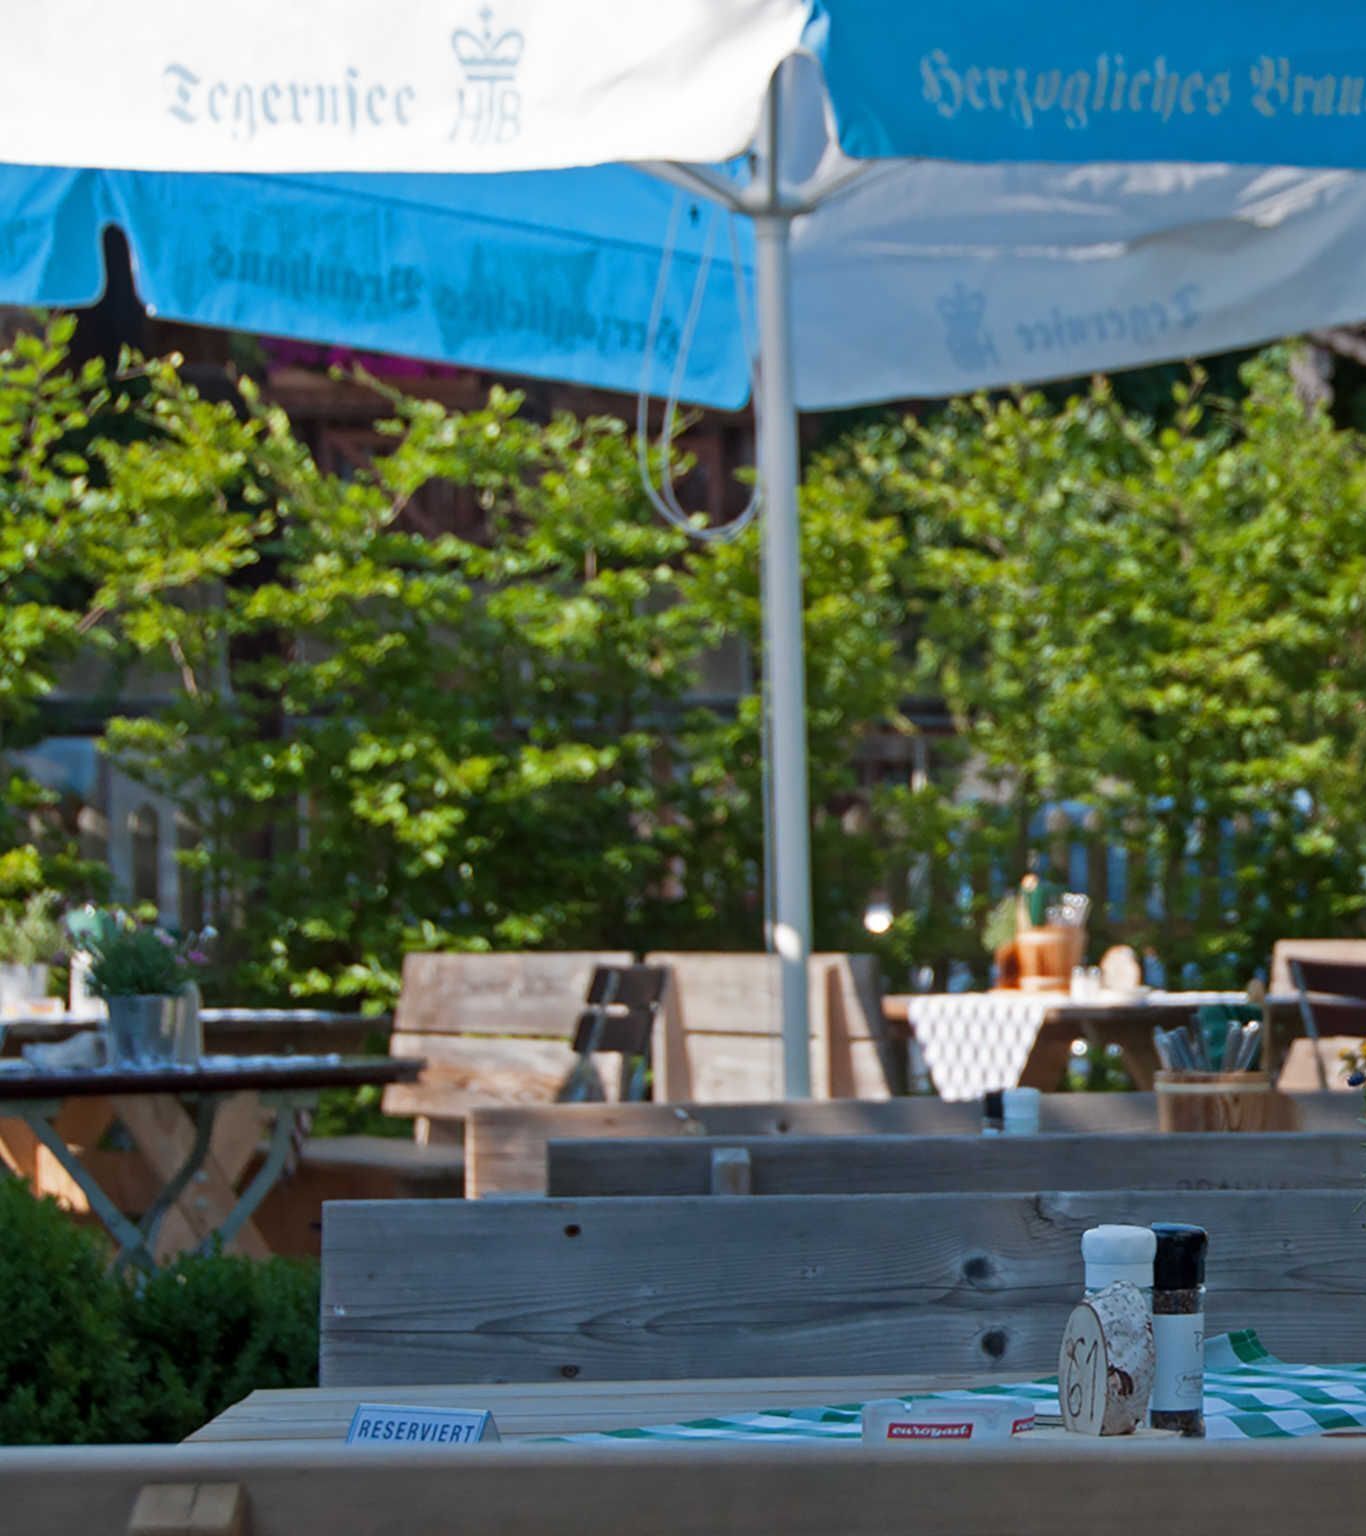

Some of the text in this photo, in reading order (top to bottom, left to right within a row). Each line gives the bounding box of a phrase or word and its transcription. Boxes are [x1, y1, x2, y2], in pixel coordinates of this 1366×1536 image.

[164, 62, 416, 140] Tegernsee
[920, 48, 1231, 130] Herzogliches
[358, 1419, 475, 1443] RESERVIERT
